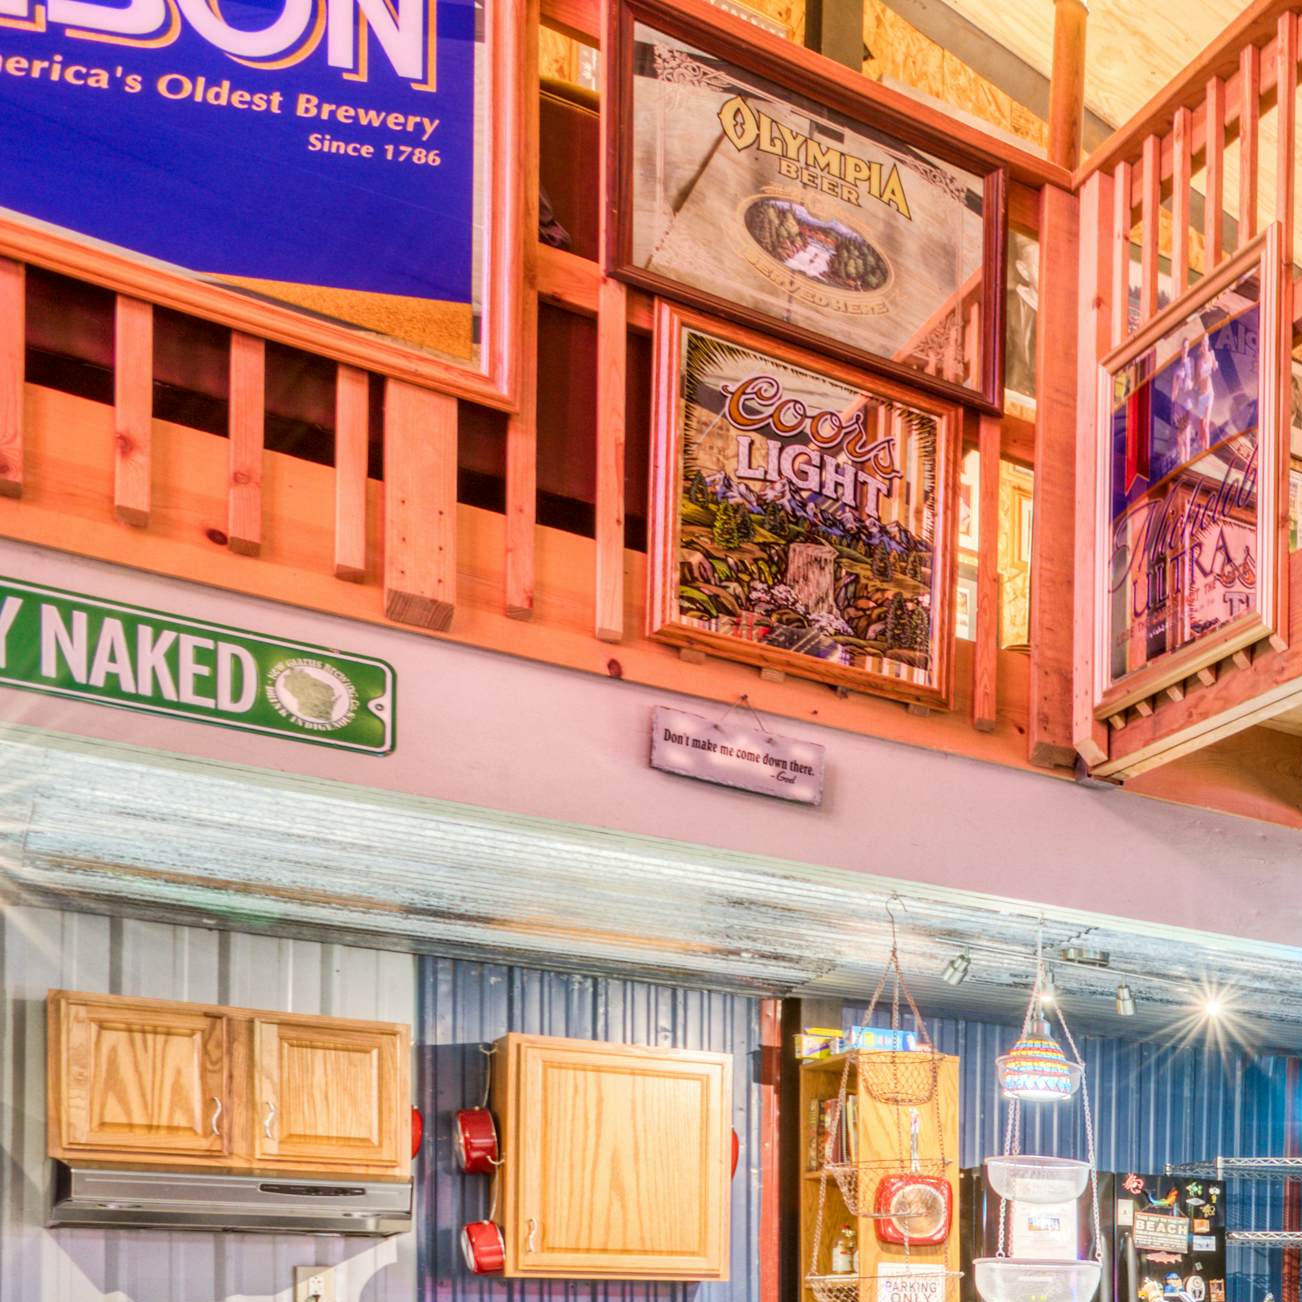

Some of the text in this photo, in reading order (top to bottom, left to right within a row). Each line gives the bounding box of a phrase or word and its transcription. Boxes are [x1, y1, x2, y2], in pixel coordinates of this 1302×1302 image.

[156, 73, 283, 114] Oldest
[296, 93, 440, 142] Brewery
[308, 132, 442, 167] Since 1786
[717, 94, 913, 222] OLYMPIA
[778, 157, 863, 208] BEER
[719, 375, 903, 480] Coors
[735, 434, 891, 521] LIGHT
[1109, 443, 1258, 593] Michelob
[1132, 523, 1234, 619] ULTRA
[41, 603, 258, 714] NAKED
[663, 728, 815, 777] Don't make me come down there.
[1135, 1219, 1187, 1235] BEACH
[885, 1280, 937, 1293] PARKING
